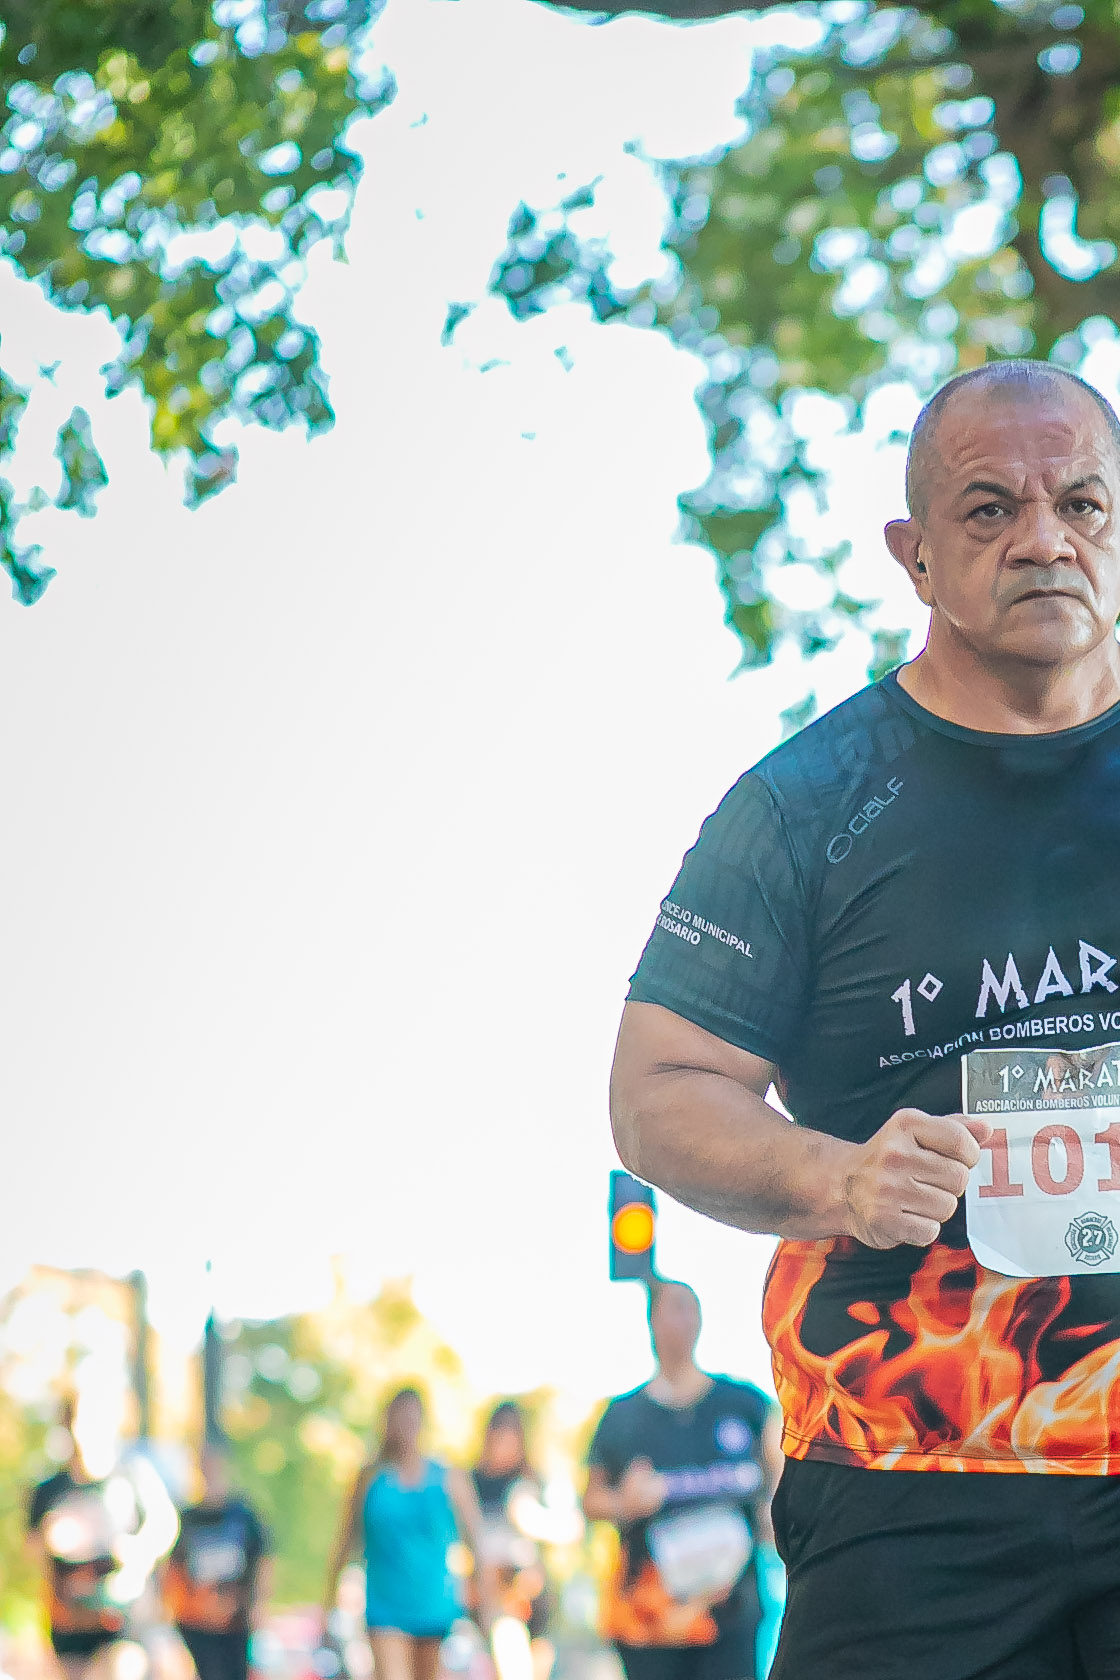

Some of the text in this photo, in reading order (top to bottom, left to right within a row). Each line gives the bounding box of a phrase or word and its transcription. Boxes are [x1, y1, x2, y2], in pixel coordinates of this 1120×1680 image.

[692, 914, 753, 959] MUNICIPAL
[988, 1013, 1095, 1041] BOMBEROS
[975, 1098, 1034, 1113] ASOCIACIÓN
[1035, 1095, 1090, 1110] BOMBEROS
[1081, 1227, 1103, 1248] 27
